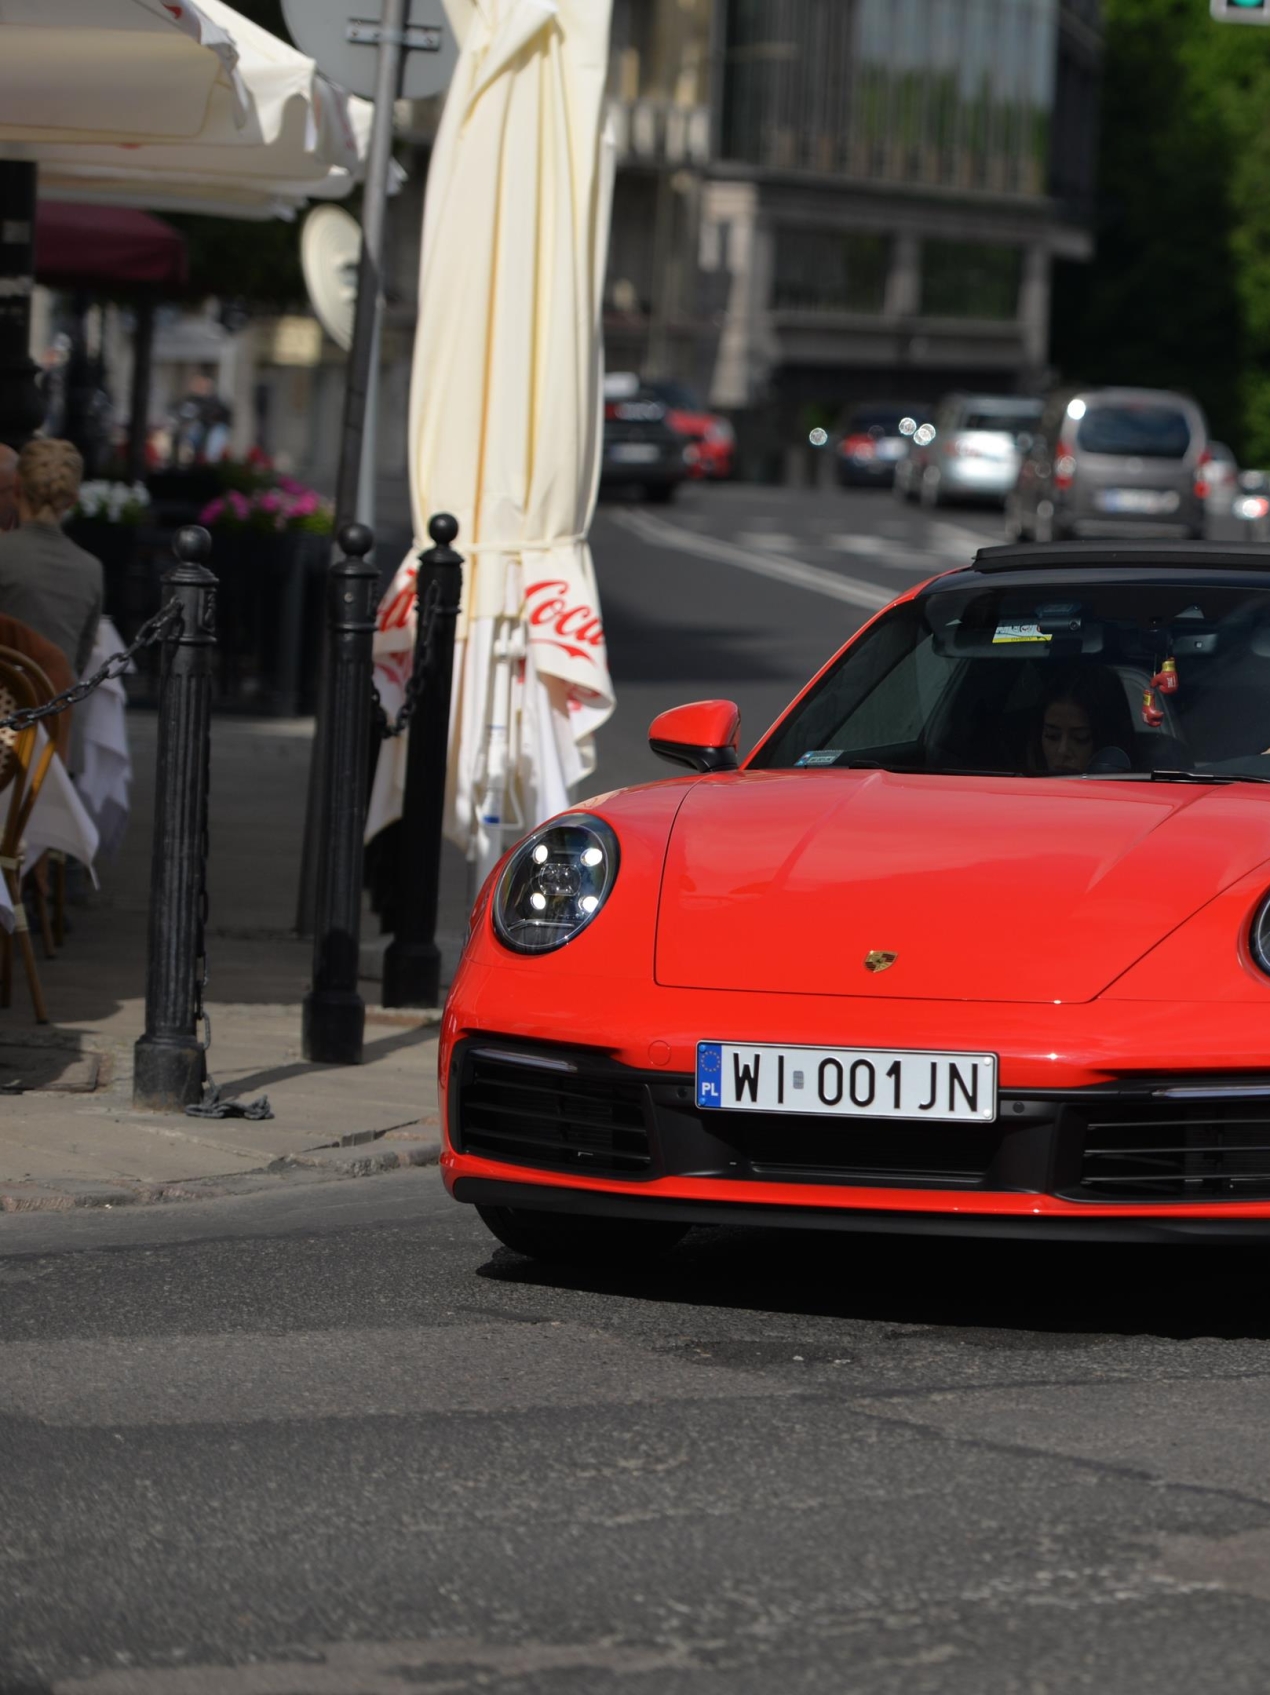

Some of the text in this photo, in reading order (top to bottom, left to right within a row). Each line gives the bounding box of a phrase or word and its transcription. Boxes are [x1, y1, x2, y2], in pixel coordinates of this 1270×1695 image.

[701, 1082, 719, 1097] PL
[733, 1052, 979, 1112] WI 001JN
